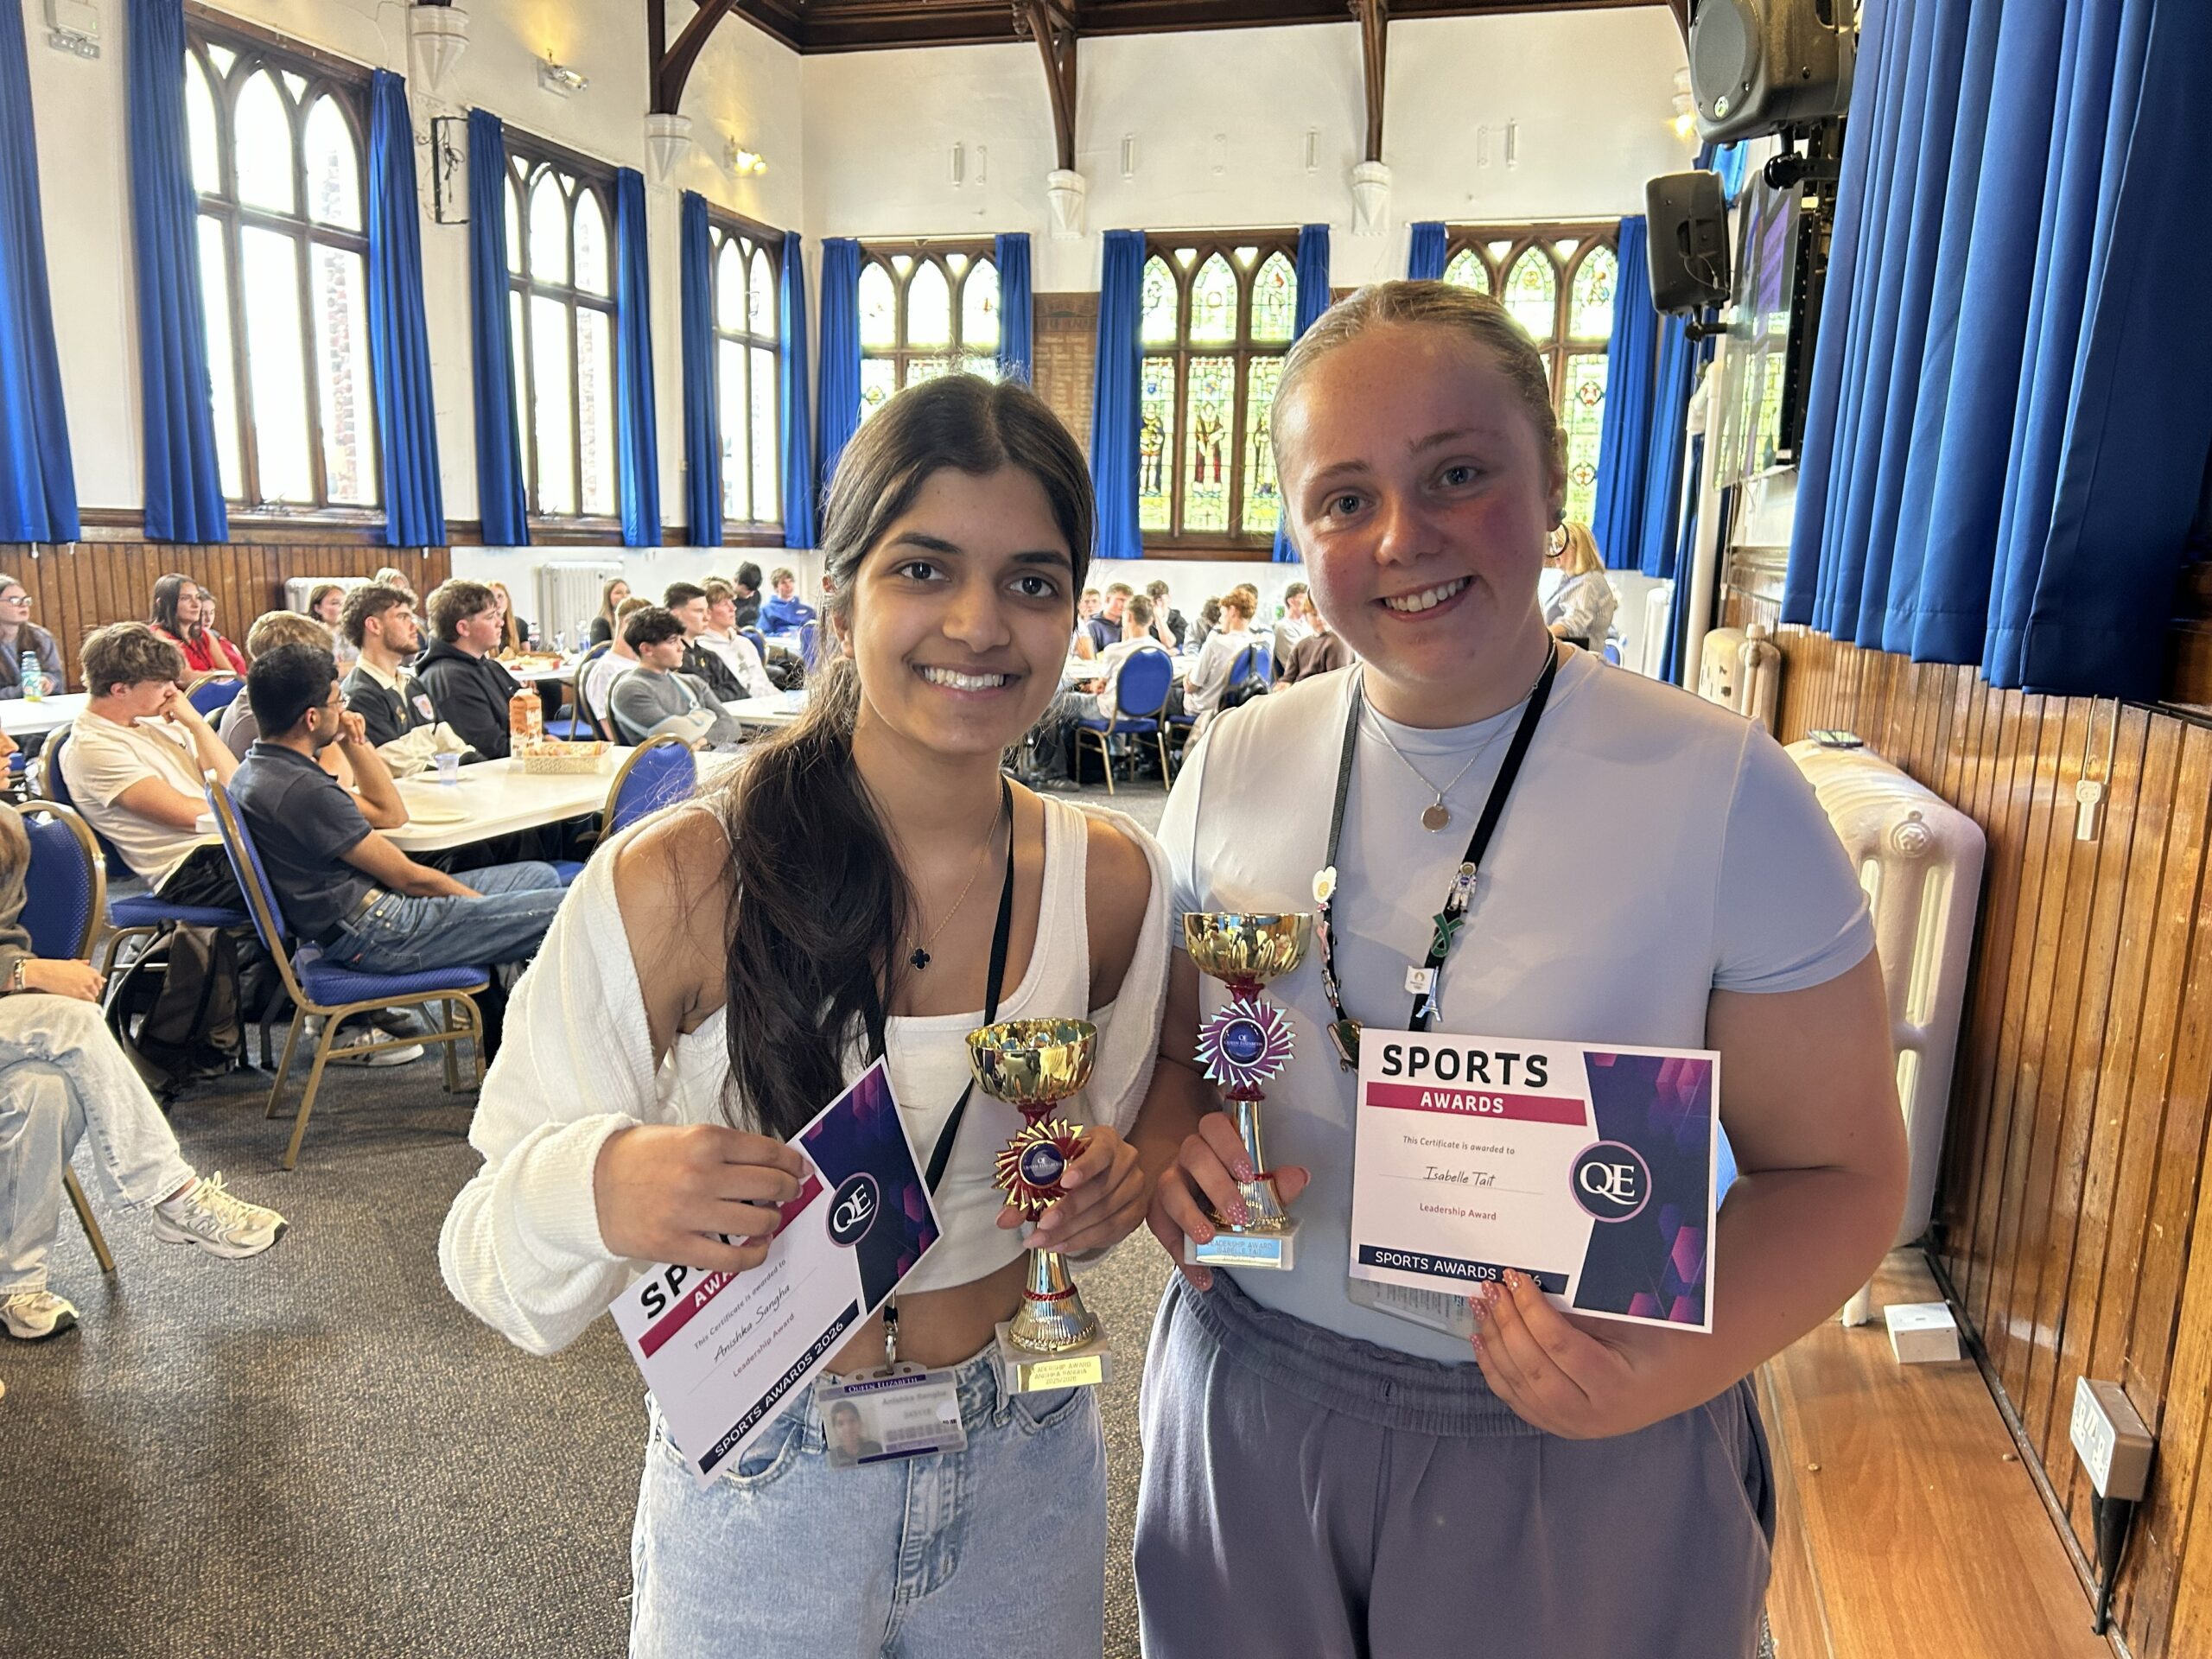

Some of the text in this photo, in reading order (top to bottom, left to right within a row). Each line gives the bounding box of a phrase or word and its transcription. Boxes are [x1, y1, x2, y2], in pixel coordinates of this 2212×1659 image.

[1381, 1044, 1548, 1088] SPORTS
[1421, 1091, 1503, 1114] AWARDS
[1402, 1135, 1418, 1145] This
[1420, 1137, 1459, 1149] Certificate
[1462, 1141, 1468, 1150] is
[1471, 1143, 1504, 1154] awarded
[1423, 1166, 1496, 1186] Isabelle Tait
[1580, 1161, 1638, 1205] QE
[833, 1184, 874, 1233] QE
[1420, 1203, 1497, 1220] Leadership Award
[1375, 1251, 1428, 1269] SPORTS
[1433, 1260, 1497, 1281] AWARDS
[693, 1271, 734, 1308] AWA
[694, 1258, 786, 1351] This Certificate is awarded to
[714, 1285, 790, 1363] Anishka Sangha
[733, 1313, 795, 1377] Leadership Award
[715, 1321, 843, 1457] SPORTS AWARDS 2026
